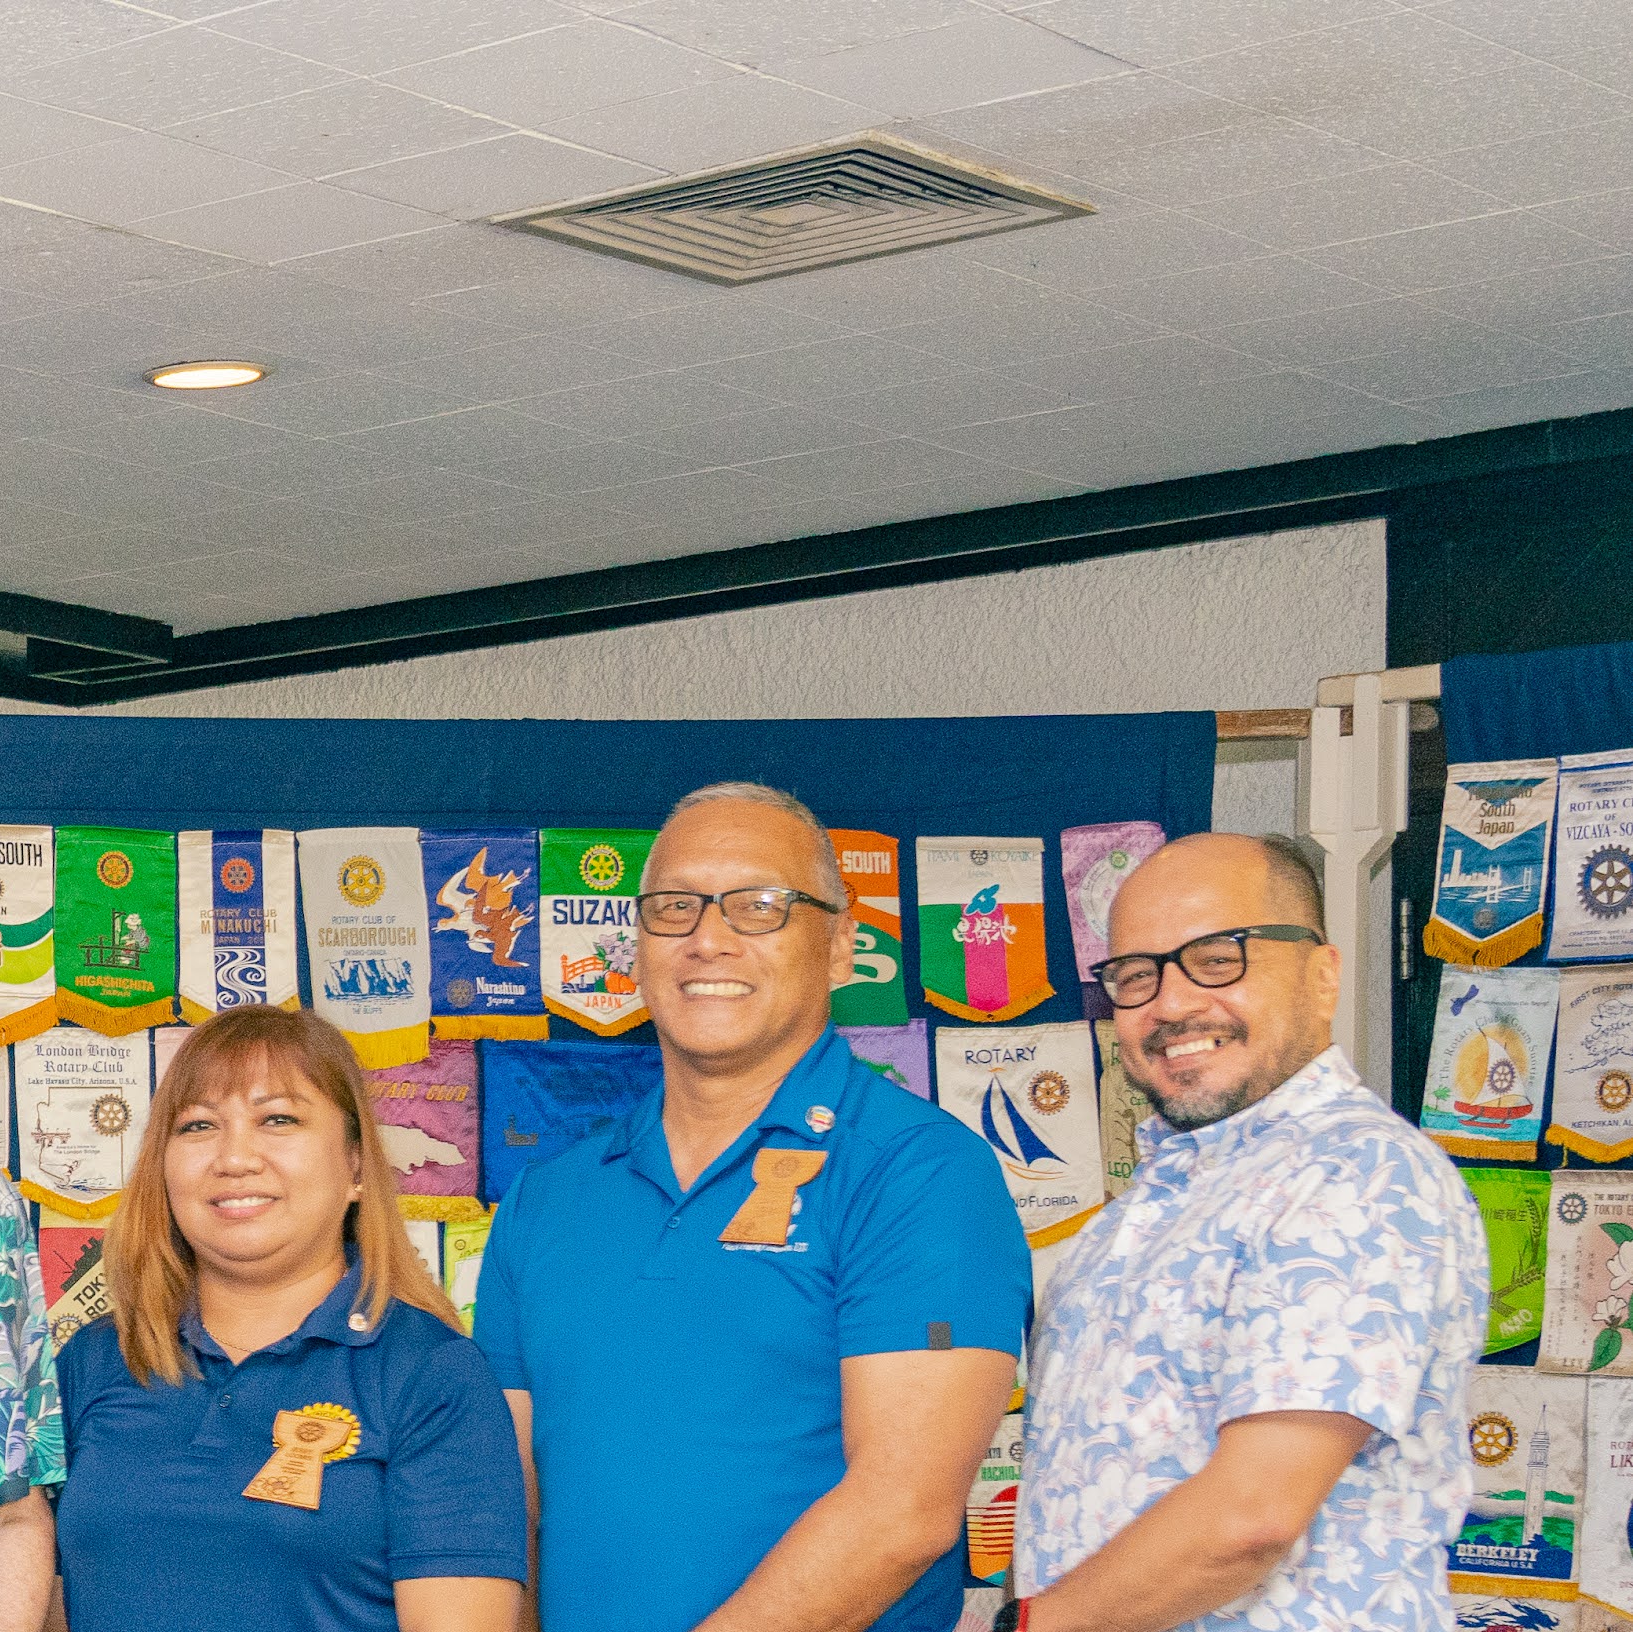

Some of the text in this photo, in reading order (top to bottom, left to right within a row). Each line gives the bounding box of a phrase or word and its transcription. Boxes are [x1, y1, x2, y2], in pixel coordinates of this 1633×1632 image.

[1478, 801, 1516, 818] South
[1569, 799, 1618, 813] ROTARY
[1604, 813, 1617, 821] OF
[1475, 819, 1515, 837] Japan
[1566, 825, 1610, 841] VIZCAYA
[842, 850, 892, 875] SOUTH
[199, 908, 277, 919] ROTARY CLUB
[331, 915, 396, 925] ROTARY CLUB OF
[552, 899, 636, 927] SUZAK
[200, 919, 277, 935] MINAKUCHI
[317, 927, 417, 948] SCARBOROUGH
[74, 975, 156, 993] HIGASHICHITA
[475, 977, 525, 996] Narashino
[486, 995, 515, 1008] Japan
[584, 995, 622, 1009] JAPAN
[34, 1044, 131, 1060] London Bridge
[964, 1045, 1038, 1064] ROTARY
[43, 1060, 124, 1074] Rotary Club
[1028, 1195, 1079, 1208] FLORIDA
[1455, 1543, 1539, 1562] BERKELEY
